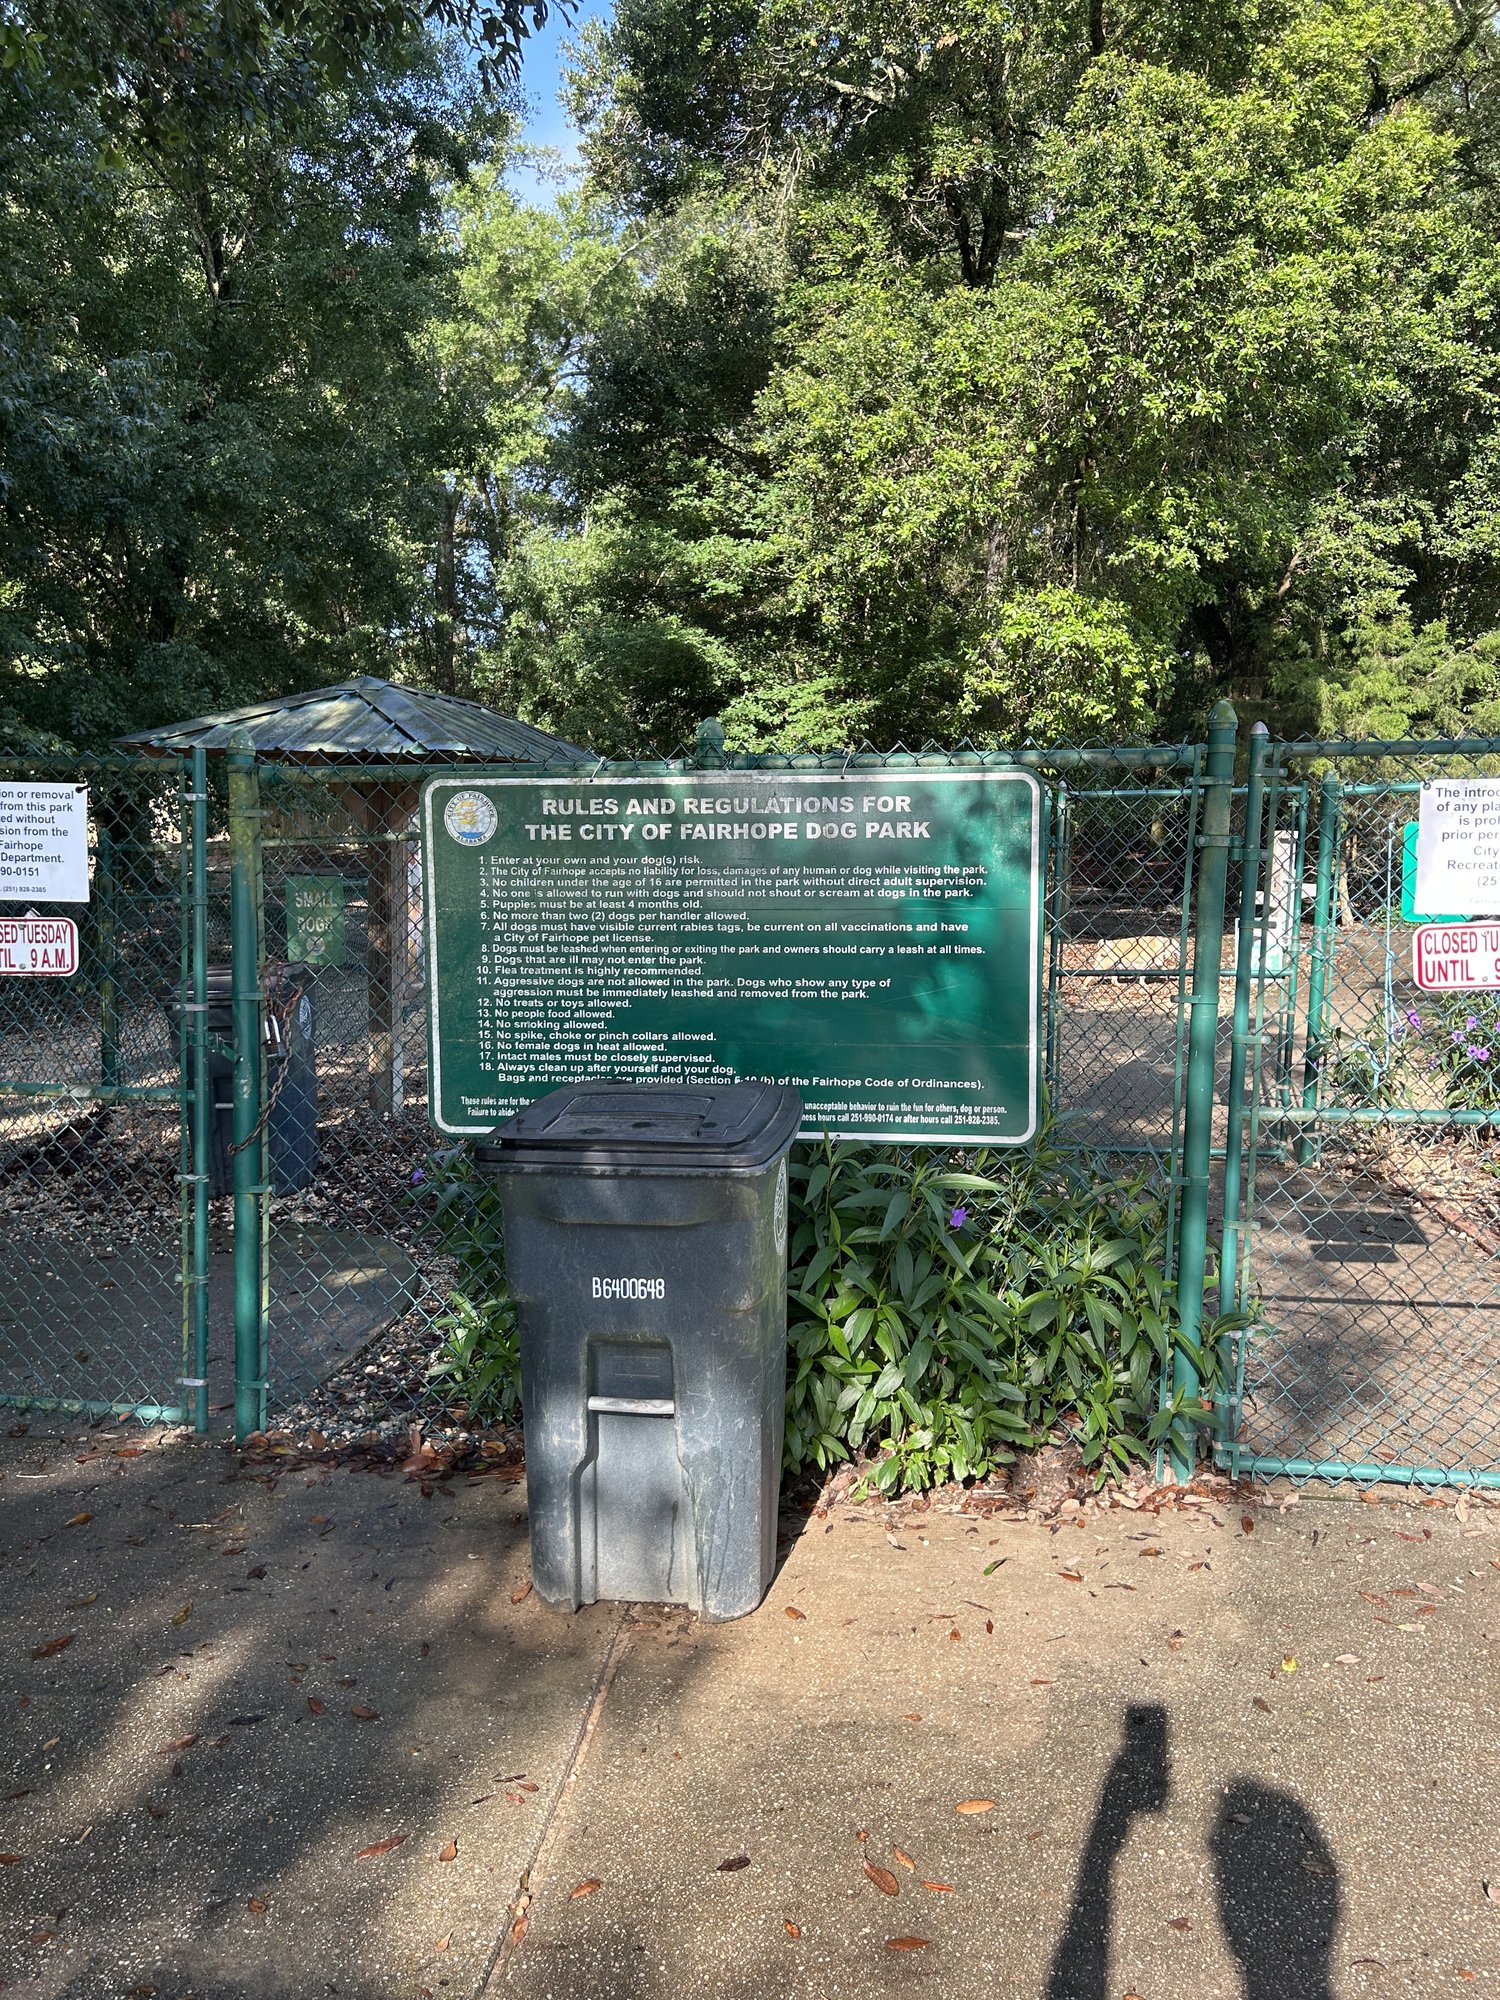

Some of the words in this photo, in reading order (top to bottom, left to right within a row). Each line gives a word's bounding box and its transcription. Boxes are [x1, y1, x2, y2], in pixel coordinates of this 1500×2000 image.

[31, 790, 74, 800] removal
[1435, 787, 1460, 798] The
[0, 801, 24, 810] from
[26, 802, 46, 812] this
[50, 803, 73, 814] park
[542, 798, 618, 814] RULES
[625, 798, 676, 814] AND
[683, 796, 854, 814] REGULATIONS
[862, 796, 911, 812] FOR
[1436, 801, 1450, 812] of
[1454, 803, 1478, 814] any
[16, 814, 56, 824] without
[1459, 815, 1470, 826] is
[24, 826, 48, 836] from
[52, 827, 68, 836] the
[524, 824, 572, 840] THE
[579, 824, 634, 840] CITY
[641, 824, 672, 840] OF
[680, 822, 798, 839] FAIRHOPE
[806, 822, 857, 838] DOG
[865, 822, 931, 838] PARK
[1442, 830, 1473, 842] prior
[0, 852, 64, 864] Department.
[1474, 846, 1500, 858] City
[479, 856, 487, 864] 1.
[490, 856, 520, 864] Enter
[522, 856, 533, 864] at
[535, 858, 560, 866] your
[589, 856, 610, 864] and
[612, 857, 638, 866] your
[640, 855, 676, 866] dog(s)
[679, 855, 703, 863] risk.
[1448, 860, 1500, 870] Recreat
[479, 866, 488, 875] 2.
[490, 866, 508, 874] The
[510, 866, 529, 876] City
[532, 866, 542, 875] of
[544, 866, 586, 875] Fairhope
[643, 866, 679, 876] liability
[680, 866, 695, 874] for
[697, 866, 720, 876] loss,
[770, 866, 780, 874] of
[782, 868, 800, 876] any
[852, 866, 872, 876] dog
[874, 865, 901, 874] while
[903, 865, 941, 876] visiting
[943, 864, 960, 874] the
[962, 866, 988, 876] park.
[480, 900, 489, 908] 5.
[492, 900, 536, 910] Puppies
[569, 900, 583, 908] be
[586, 900, 596, 908] at
[599, 900, 625, 908] least
[628, 900, 634, 908] 4
[638, 900, 679, 908] months
[682, 900, 702, 908] old.
[18, 924, 68, 944] TUESDAY
[1424, 931, 1478, 954] CLOSED
[30, 948, 38, 968] 9
[42, 948, 70, 968] A.M.
[481, 954, 491, 963] 9.
[494, 954, 522, 964] Dogs
[525, 955, 546, 963] that
[569, 955, 578, 963] ill
[581, 957, 604, 965] may
[607, 956, 625, 964] not
[658, 956, 676, 964] the
[679, 956, 706, 966] park.
[1425, 960, 1475, 982] UNTIL
[477, 1020, 493, 1028] 14.
[496, 1020, 511, 1028] No
[514, 1020, 560, 1030] smoking
[563, 1020, 607, 1028] allowed.
[479, 1062, 494, 1070] 18.
[496, 1062, 536, 1072] Always
[538, 1063, 567, 1071] clean
[570, 1065, 584, 1073] up
[586, 1063, 612, 1072] after
[613, 1064, 658, 1073] yourself
[660, 1064, 681, 1072] and
[684, 1066, 710, 1074] your
[712, 1064, 736, 1075] dog.
[498, 1073, 526, 1084] Bags
[528, 1074, 548, 1082] and
[636, 1075, 682, 1084] provided
[686, 1076, 731, 1084] (Section
[778, 1076, 790, 1086] of
[792, 1076, 810, 1086] the
[812, 1076, 862, 1088] Fairhope
[864, 1078, 894, 1087] Code
[897, 1078, 909, 1087] of
[912, 1078, 985, 1090] Ordinances).
[460, 1096, 480, 1105] These
[481, 1096, 496, 1105] rules
[510, 1096, 518, 1106] for
[520, 1096, 530, 1106] the
[468, 1107, 488, 1116] Failure
[490, 1108, 496, 1116] to
[804, 1102, 848, 1112] unacceptable
[849, 1102, 877, 1111] behavior
[878, 1102, 885, 1111] to
[886, 1102, 900, 1111] ruin
[900, 1103, 912, 1112] the
[912, 1103, 924, 1112] fun
[924, 1103, 934, 1112] for
[936, 1104, 958, 1114] others,
[960, 1104, 972, 1114] dog
[974, 1105, 981, 1113] or
[982, 1106, 1008, 1114] person.
[818, 1112, 836, 1122] hours
[838, 1113, 850, 1122] call
[894, 1115, 902, 1123] or
[904, 1114, 920, 1124] after
[920, 1114, 940, 1124] hours
[940, 1115, 952, 1124] call
[592, 1276, 665, 1299] B6400648
